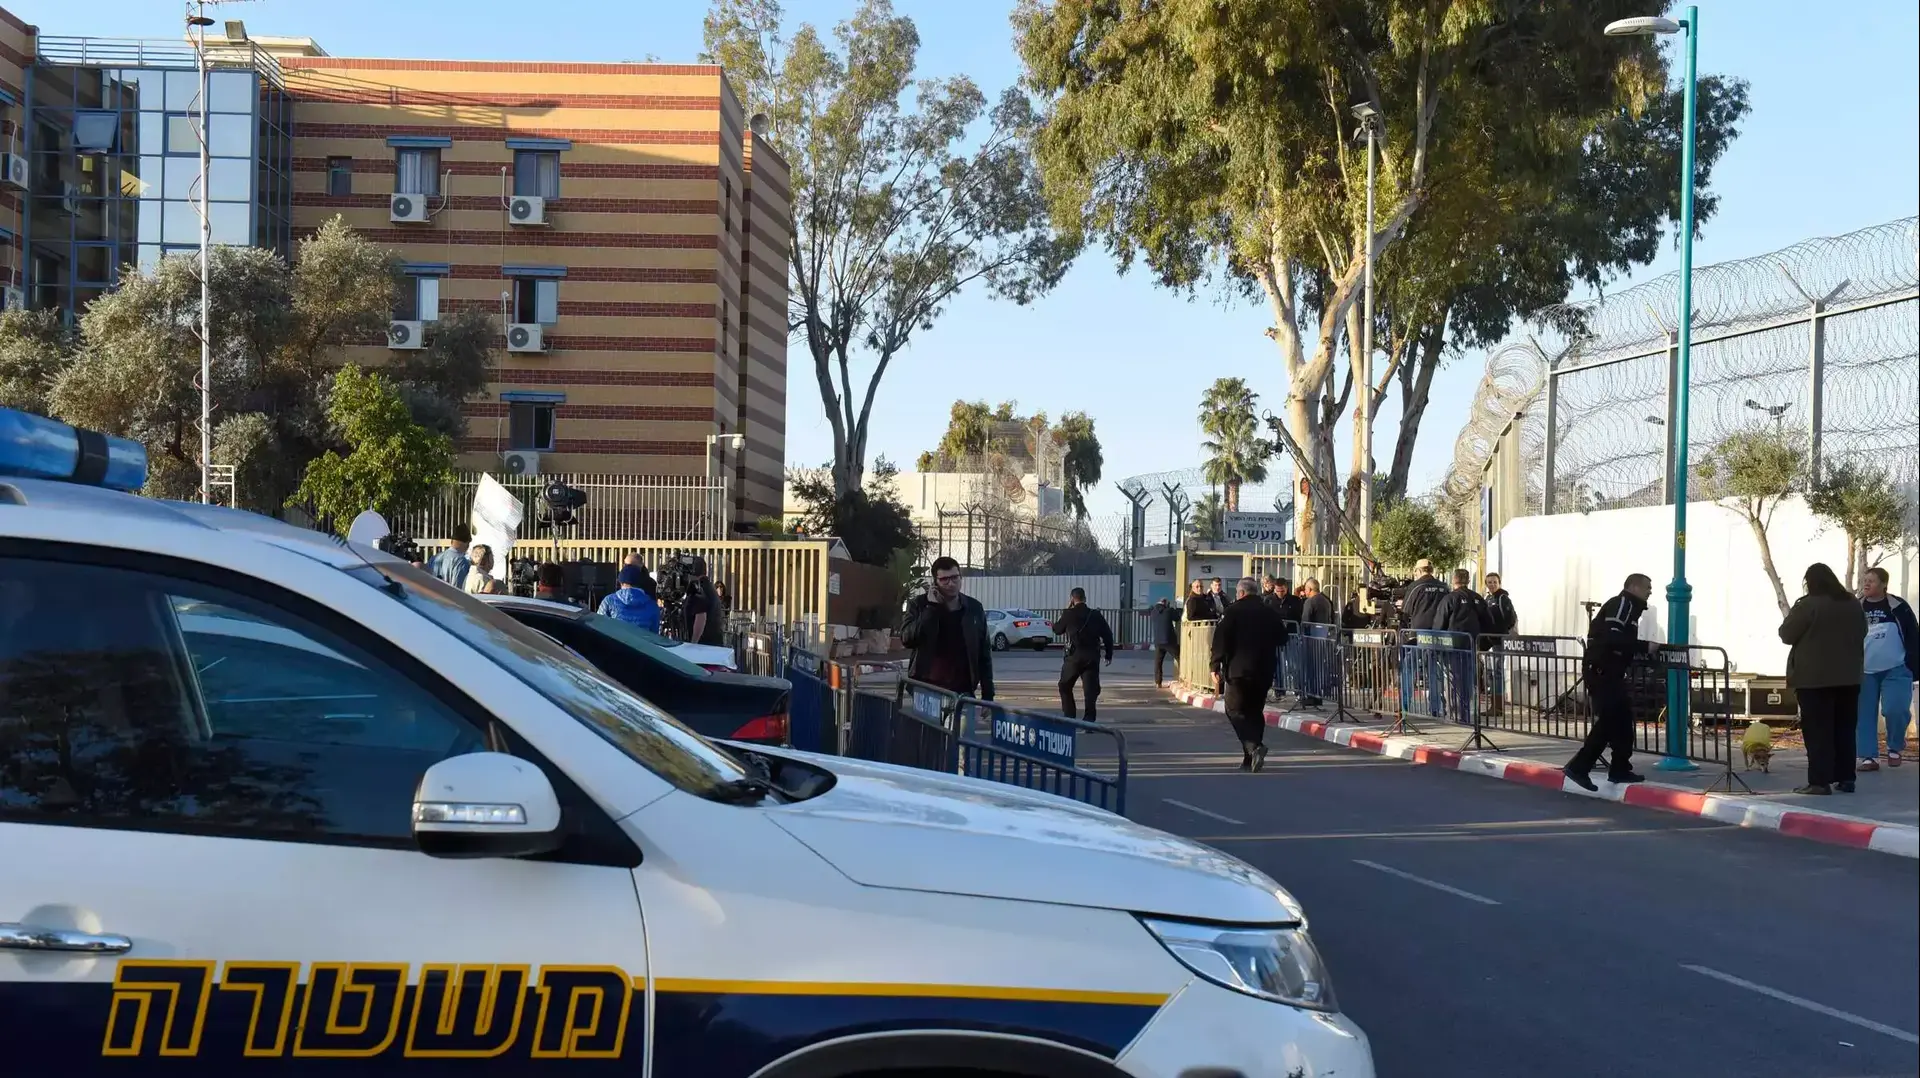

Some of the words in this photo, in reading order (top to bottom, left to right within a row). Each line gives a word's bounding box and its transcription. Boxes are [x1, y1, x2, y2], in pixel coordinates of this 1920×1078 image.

[1228, 529, 1282, 541] מעשיהו
[1503, 640, 1525, 651] POLICE
[995, 720, 1026, 746] POLICE
[1039, 729, 1073, 757] משטרה
[102, 958, 634, 1058] משטרה
